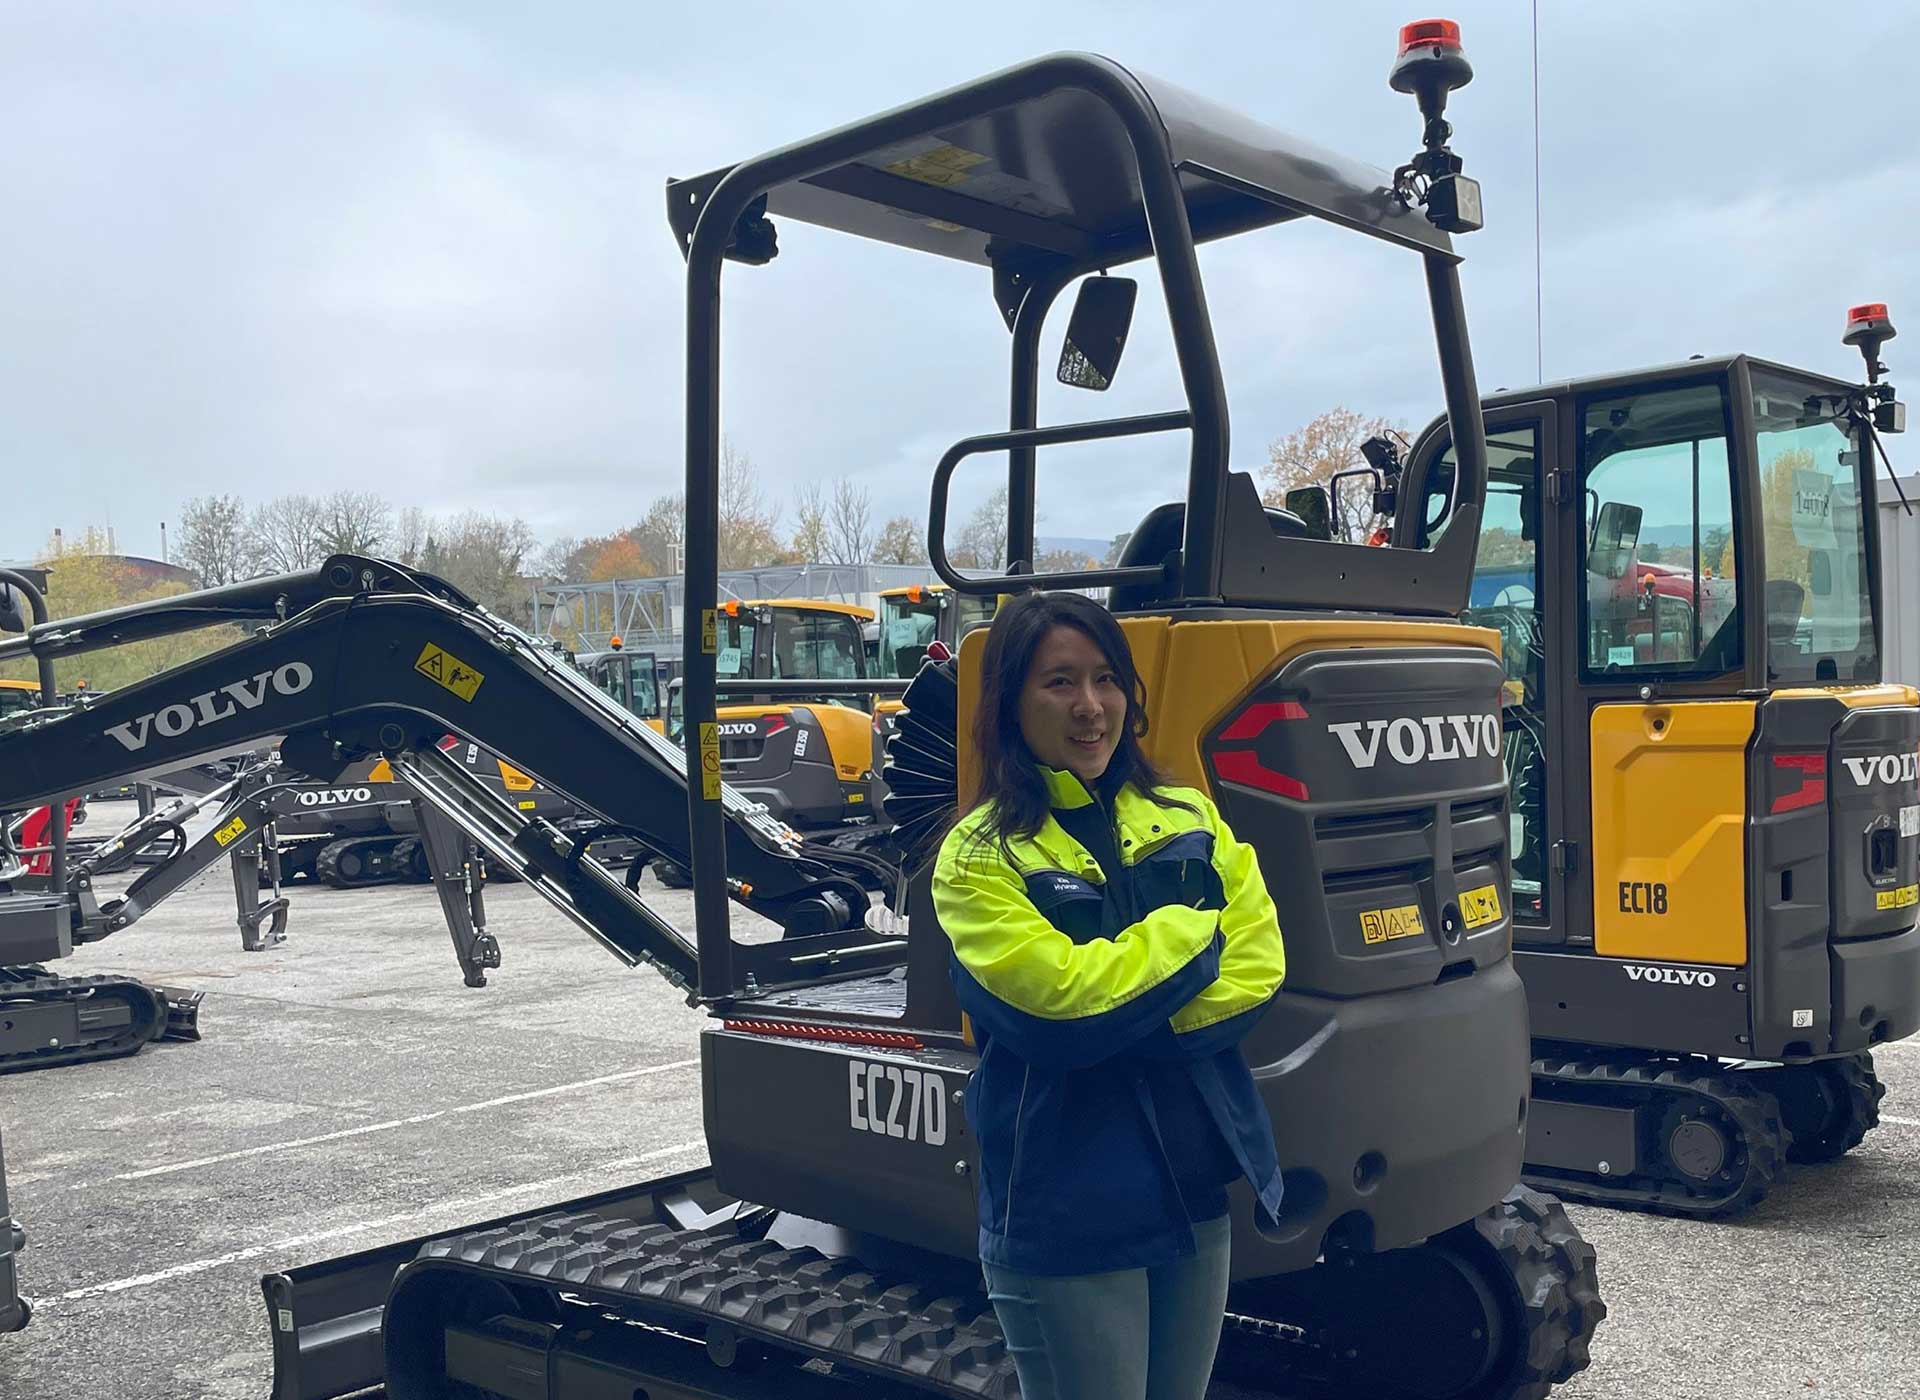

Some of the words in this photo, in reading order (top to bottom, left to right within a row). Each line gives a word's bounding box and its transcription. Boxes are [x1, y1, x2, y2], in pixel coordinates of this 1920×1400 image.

[105, 661, 313, 751] VOLVO
[1328, 714, 1499, 769] VOLVO
[297, 787, 372, 806] OLVO
[1619, 882, 1668, 915] EC18
[1622, 965, 1717, 988] VOLVO
[849, 1060, 947, 1146] EC27D
